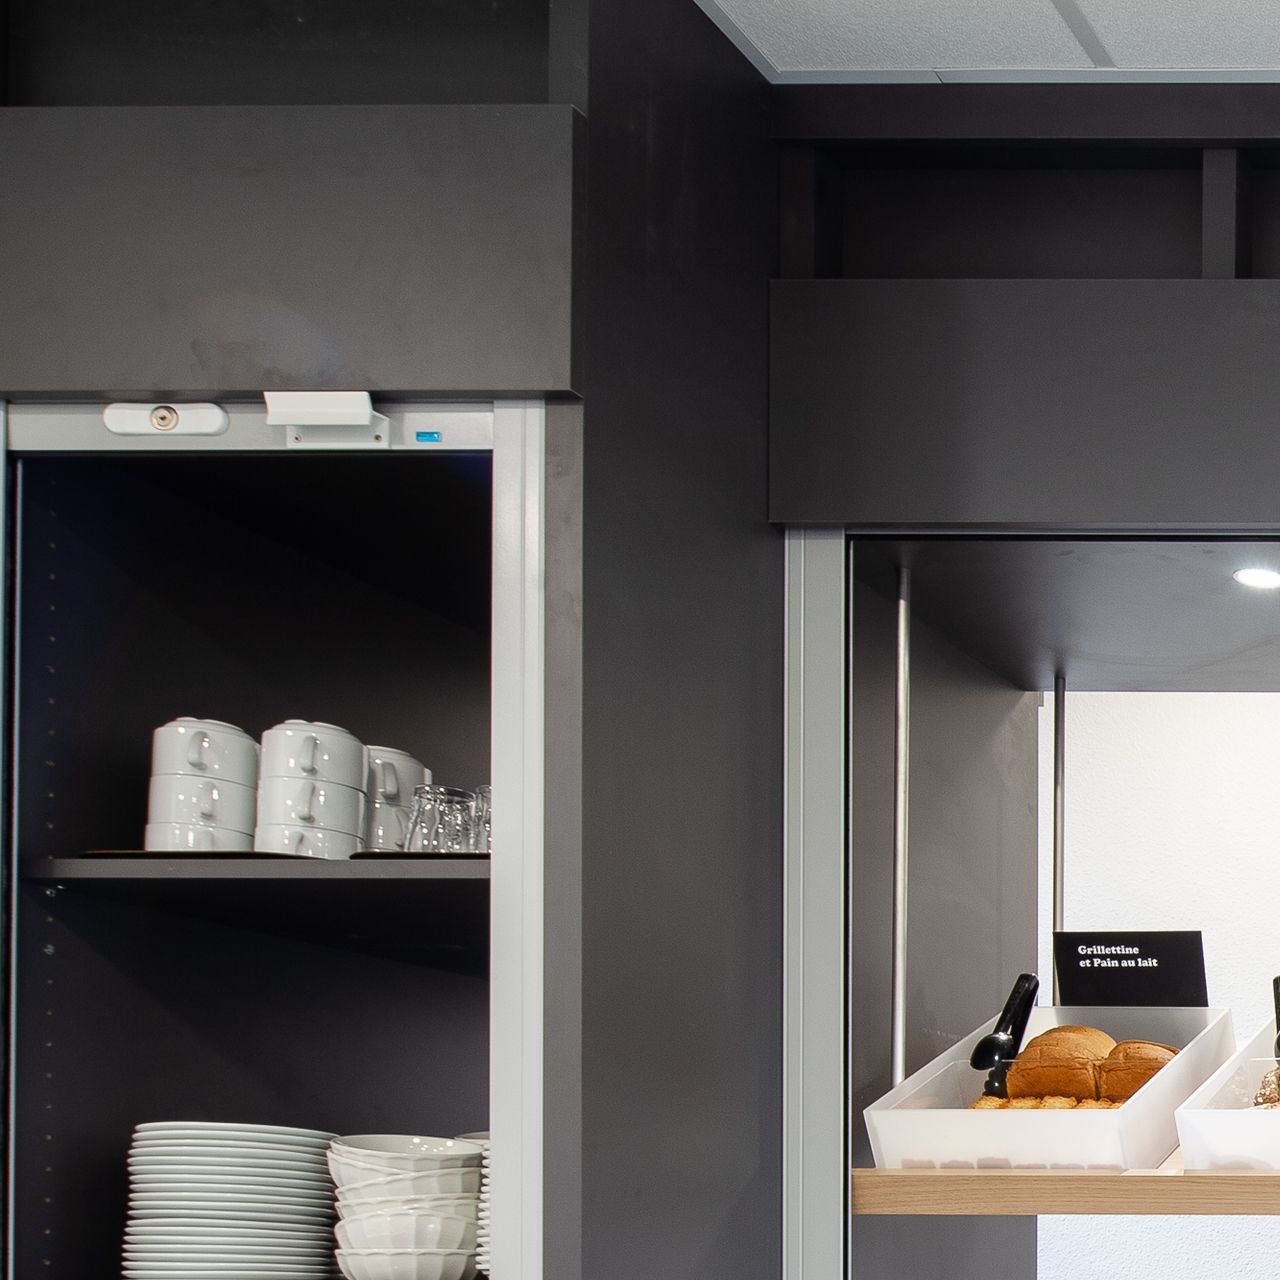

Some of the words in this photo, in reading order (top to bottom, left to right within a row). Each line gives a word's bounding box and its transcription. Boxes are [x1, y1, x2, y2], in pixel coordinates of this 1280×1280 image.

[1078, 945, 1140, 955] Grillettine
[1079, 959, 1091, 968] et
[1093, 958, 1120, 968] Pain
[1121, 959, 1136, 968] au
[1137, 958, 1158, 968] lait
